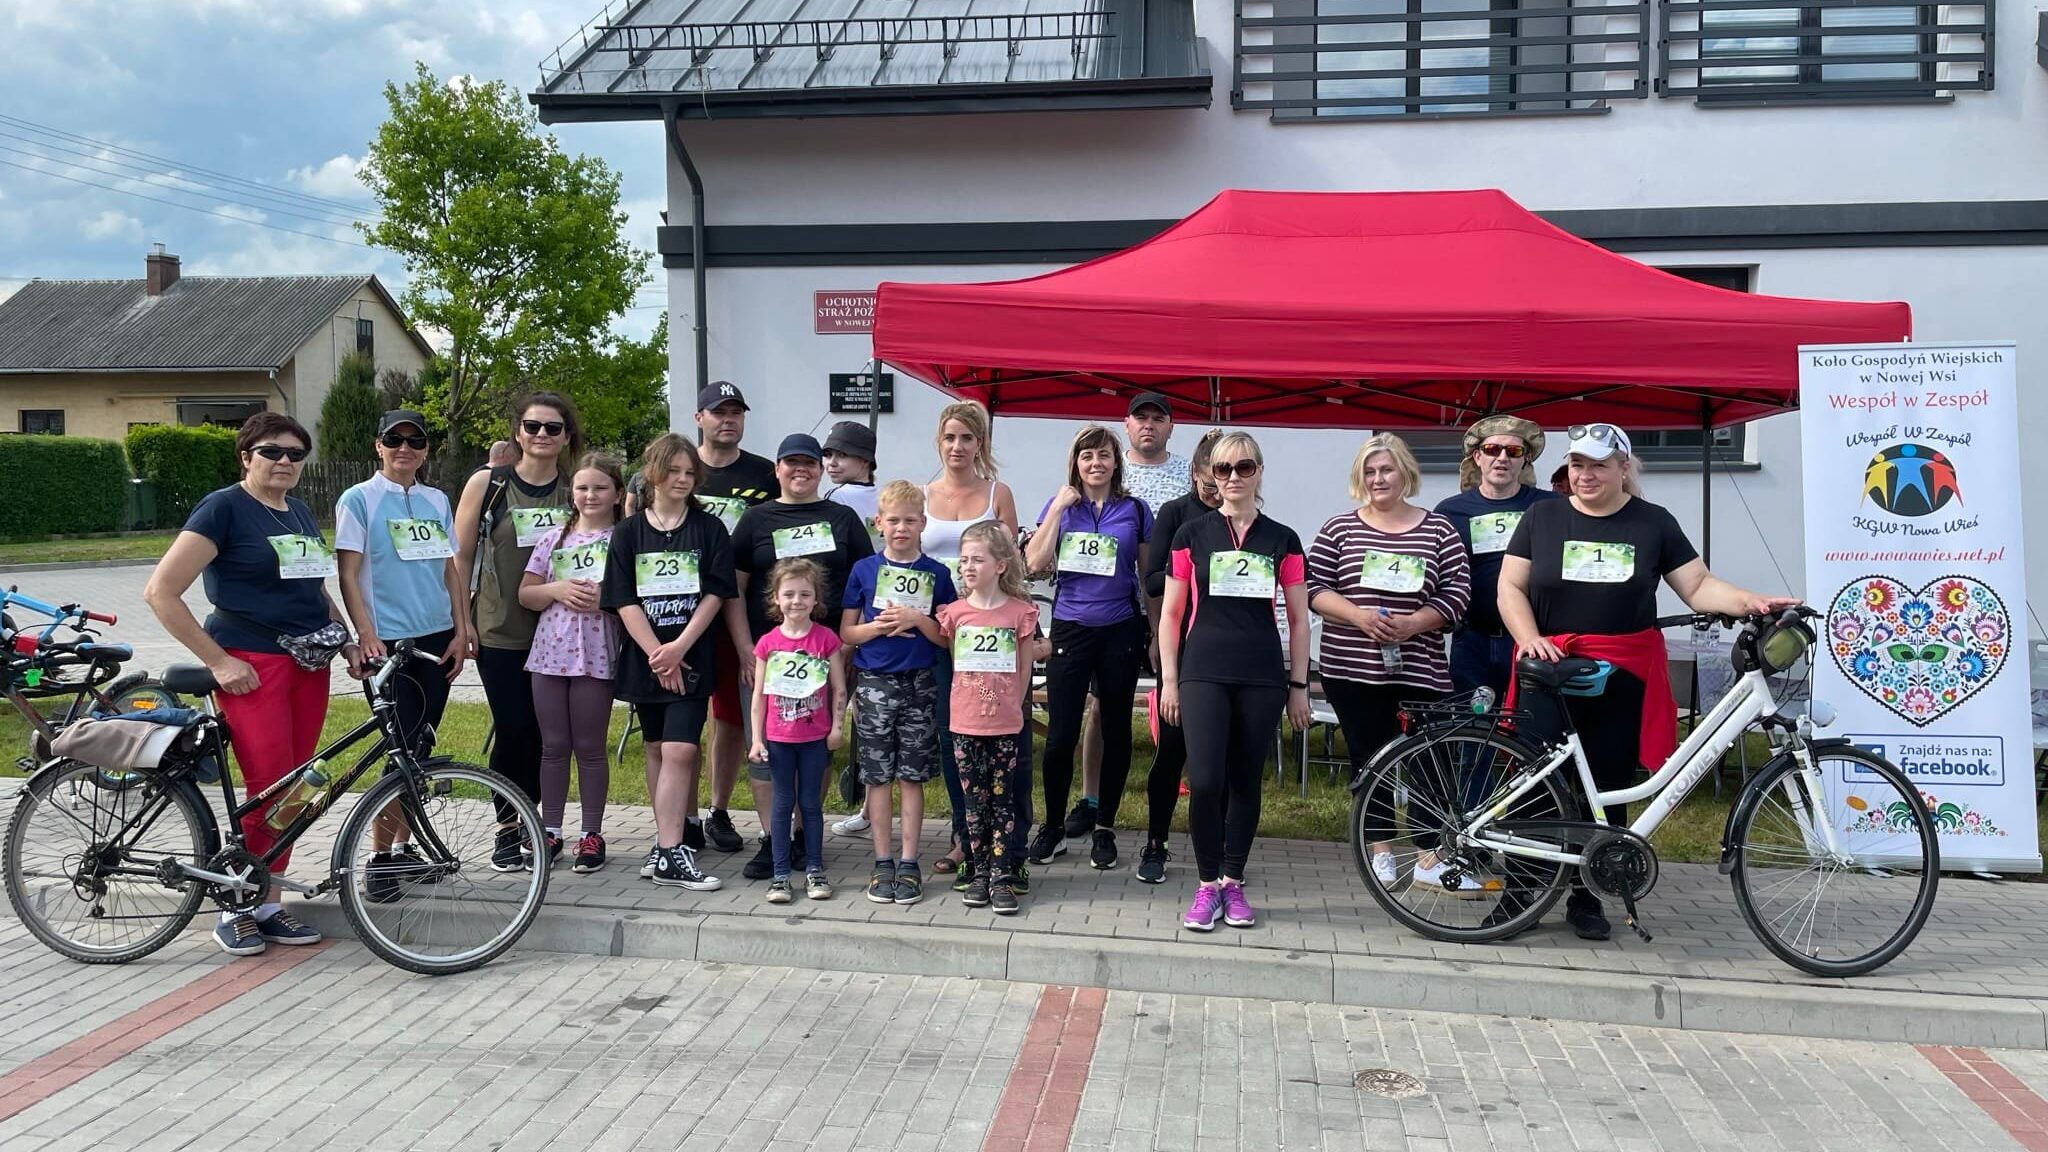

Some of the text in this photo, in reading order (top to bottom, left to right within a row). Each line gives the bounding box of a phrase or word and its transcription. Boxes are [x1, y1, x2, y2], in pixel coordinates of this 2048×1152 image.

[818, 305, 851, 317] STRAŻ
[1812, 351, 2003, 369] Koło Gospodyń Wiejskich
[1860, 370, 1956, 385] w Nowej Wsi
[1829, 389, 1989, 413] Wespół w Zespół
[703, 502, 727, 517] 27
[533, 512, 556, 528] 21
[1495, 518, 1506, 534] 5
[1852, 514, 1978, 538] KGW Nowa Wieś
[408, 525, 431, 542] 10
[790, 526, 815, 540] 24
[296, 541, 306, 557] 7
[1078, 539, 1100, 556] 18
[1592, 548, 1605, 563] 1
[1824, 546, 2005, 564] www.nowawies.net.pl
[571, 550, 595, 570] 16
[655, 559, 679, 577] 23
[1236, 558, 1249, 576] 2
[1387, 561, 1401, 575] 4
[894, 575, 919, 595] 30
[973, 634, 998, 652] 22
[783, 660, 808, 680] 26
[1899, 744, 1993, 758] Znajdź nas na:
